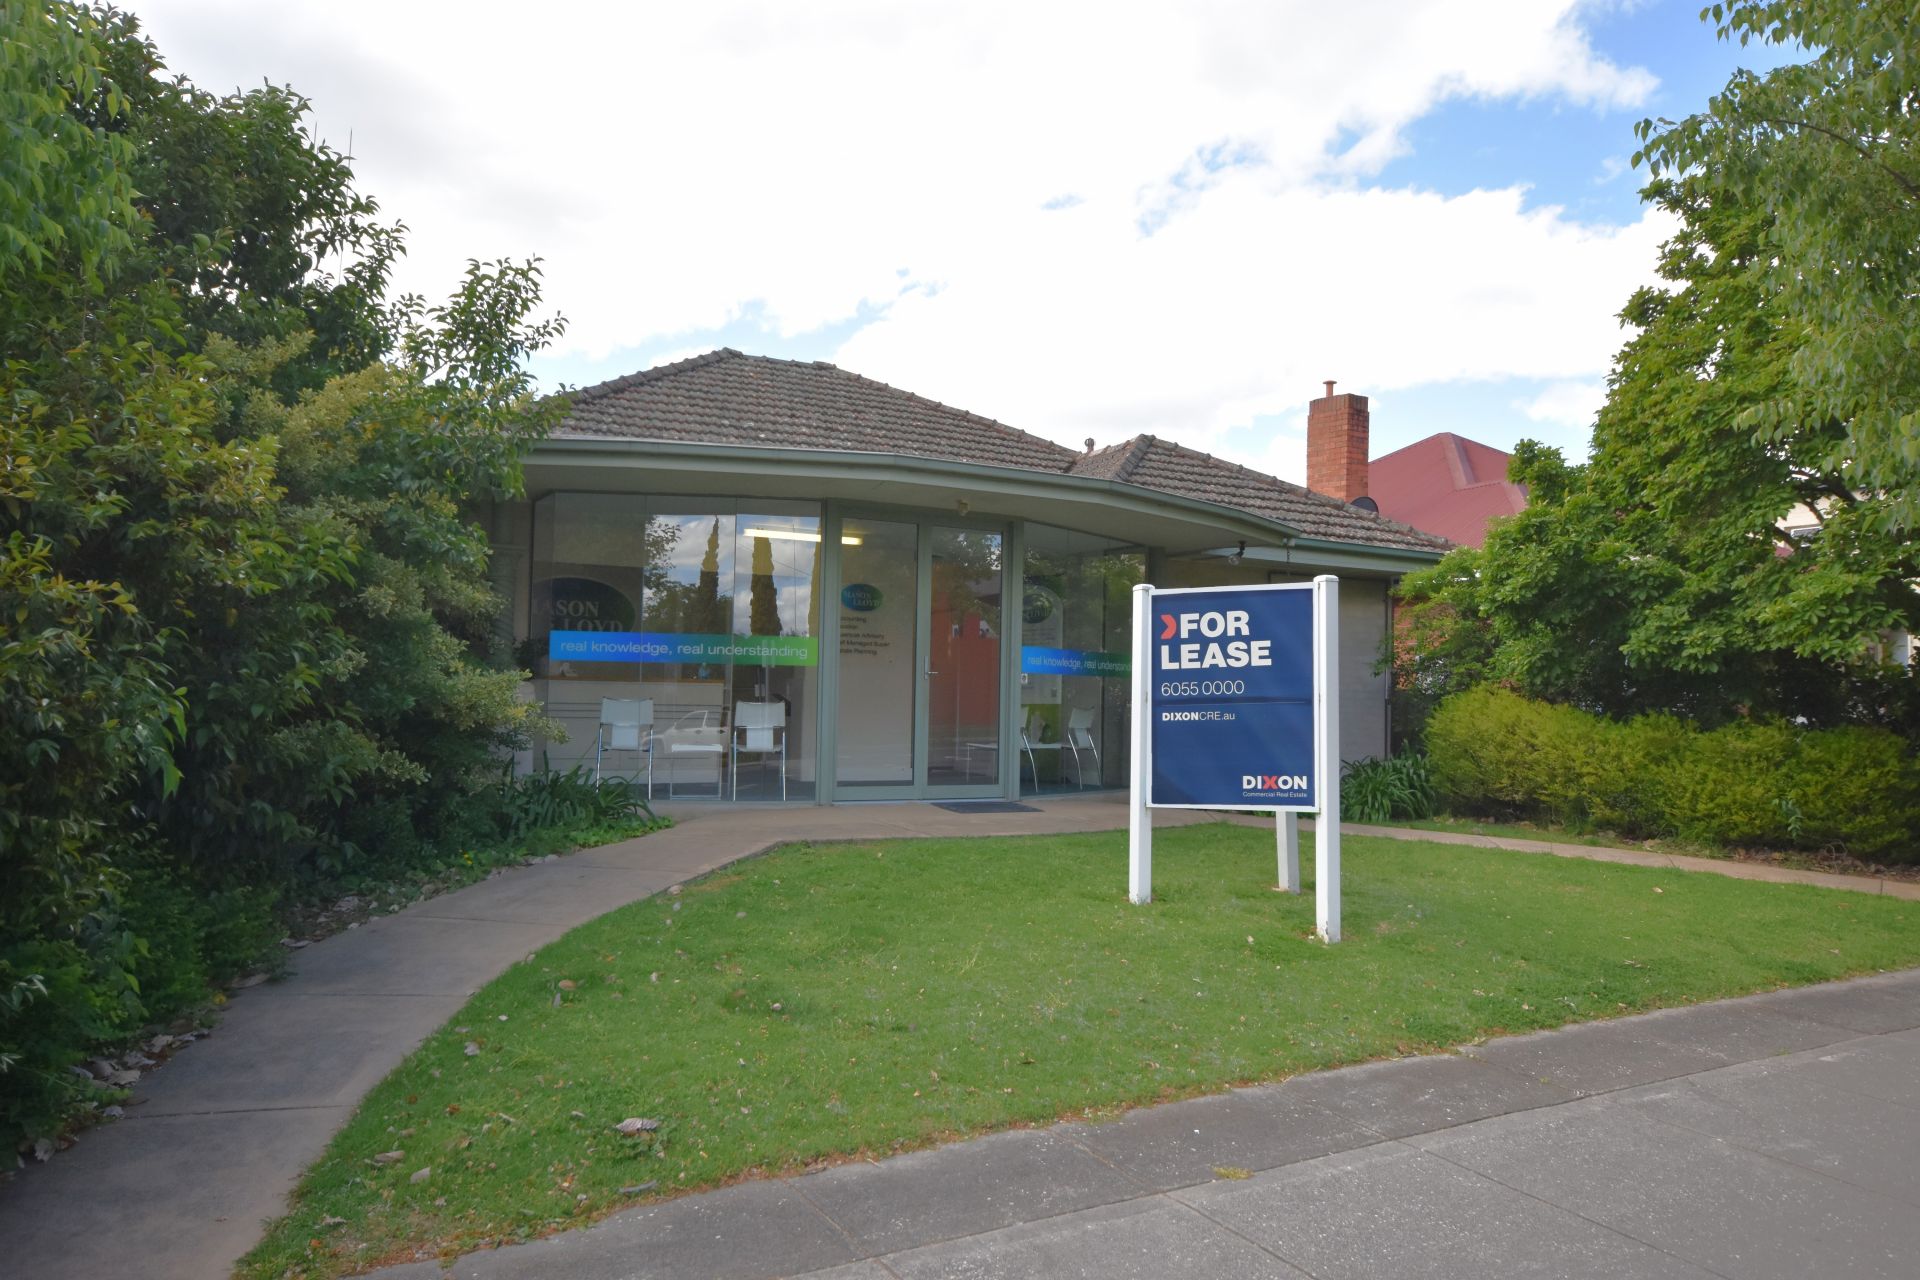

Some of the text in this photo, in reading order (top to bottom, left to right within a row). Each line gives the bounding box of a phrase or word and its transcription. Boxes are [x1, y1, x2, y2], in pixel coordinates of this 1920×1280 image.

[1180, 610, 1250, 639] FOR
[560, 641, 808, 660] real knowledge, real understanding
[1161, 640, 1272, 670] LEASE
[1027, 656, 1040, 665] real
[1084, 660, 1097, 669] real
[1161, 680, 1245, 697] 6055 0000
[1161, 711, 1236, 721] DIXONCRE.au
[1242, 775, 1308, 790] DIXON
